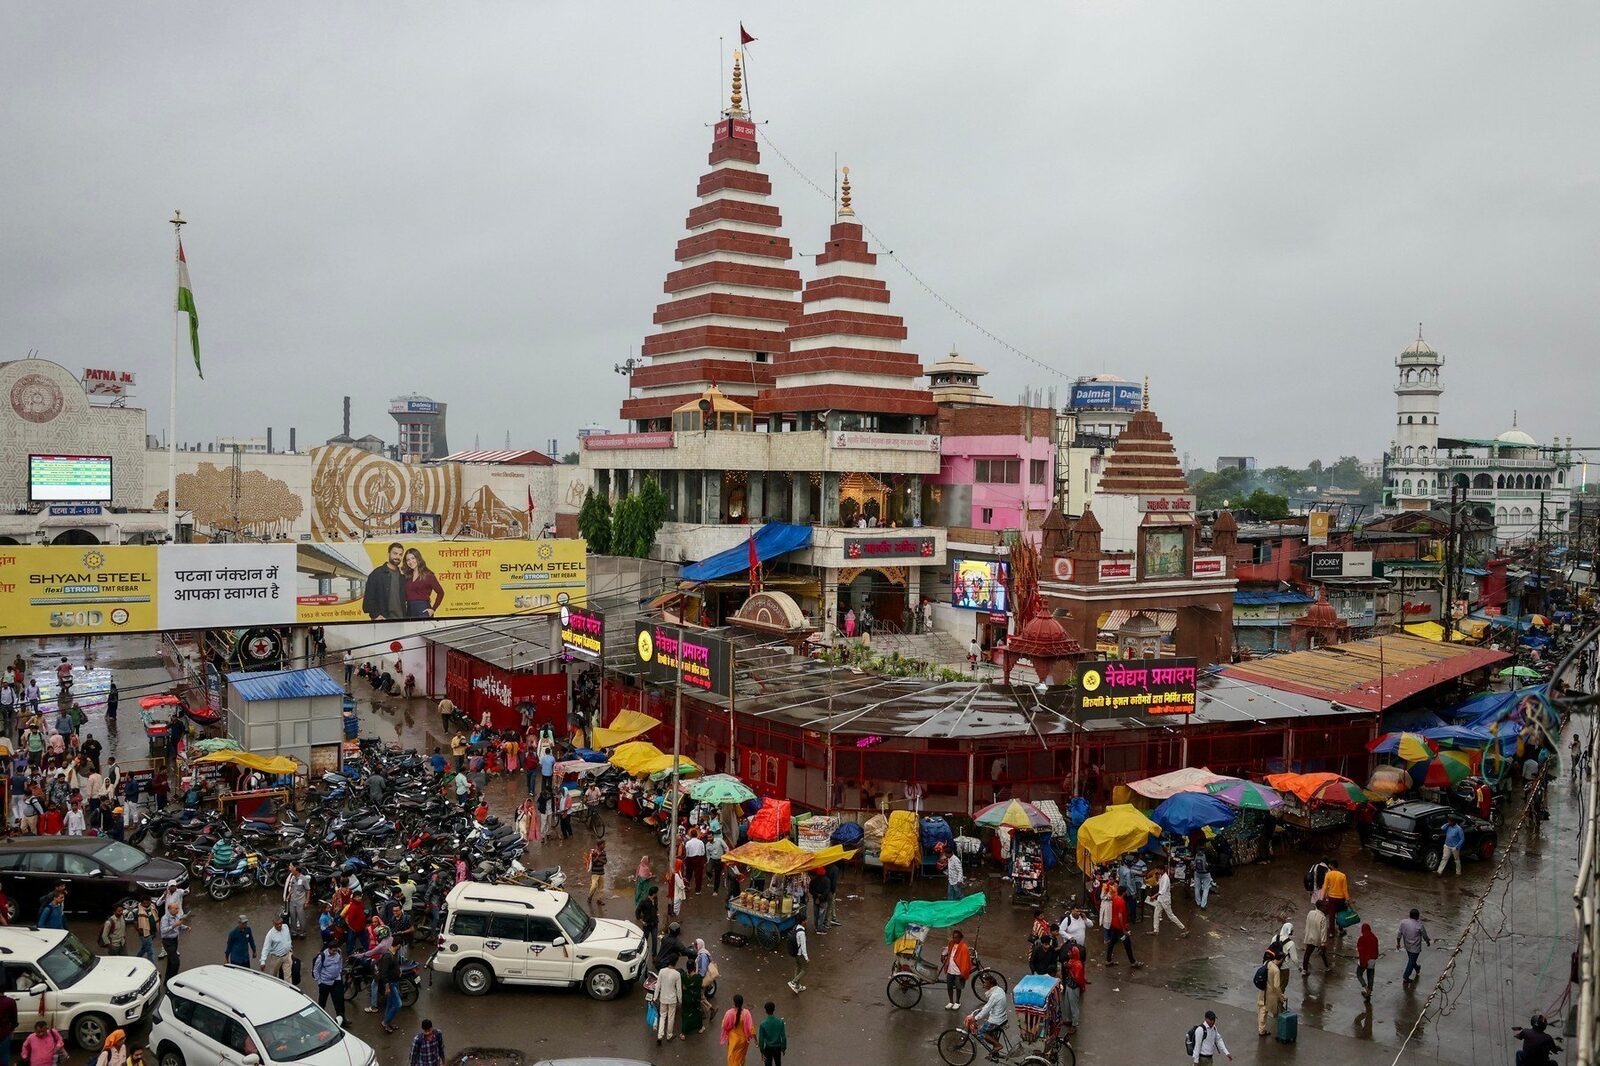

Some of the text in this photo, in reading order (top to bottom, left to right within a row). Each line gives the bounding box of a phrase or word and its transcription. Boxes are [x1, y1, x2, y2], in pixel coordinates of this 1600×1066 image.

[86, 368, 116, 381] PATNA
[1076, 389, 1111, 399] Dalmia
[452, 560, 478, 568] मतलब
[500, 562, 586, 572] SHYAM STEEL
[1315, 558, 1340, 566] JOCKEY
[29, 572, 152, 584] SHYAM STEEL
[174, 565, 279, 582] पटना जंक्शन में
[464, 570, 473, 580] के
[475, 570, 492, 580] लिए
[45, 586, 63, 594] flexi
[64, 585, 99, 593] STRONG
[174, 582, 280, 601] आपका स्वागत है
[49, 610, 104, 628] 550D
[1105, 663, 1196, 691] नैवेद्यम् प्रसादम्
[1105, 695, 1112, 706] के
